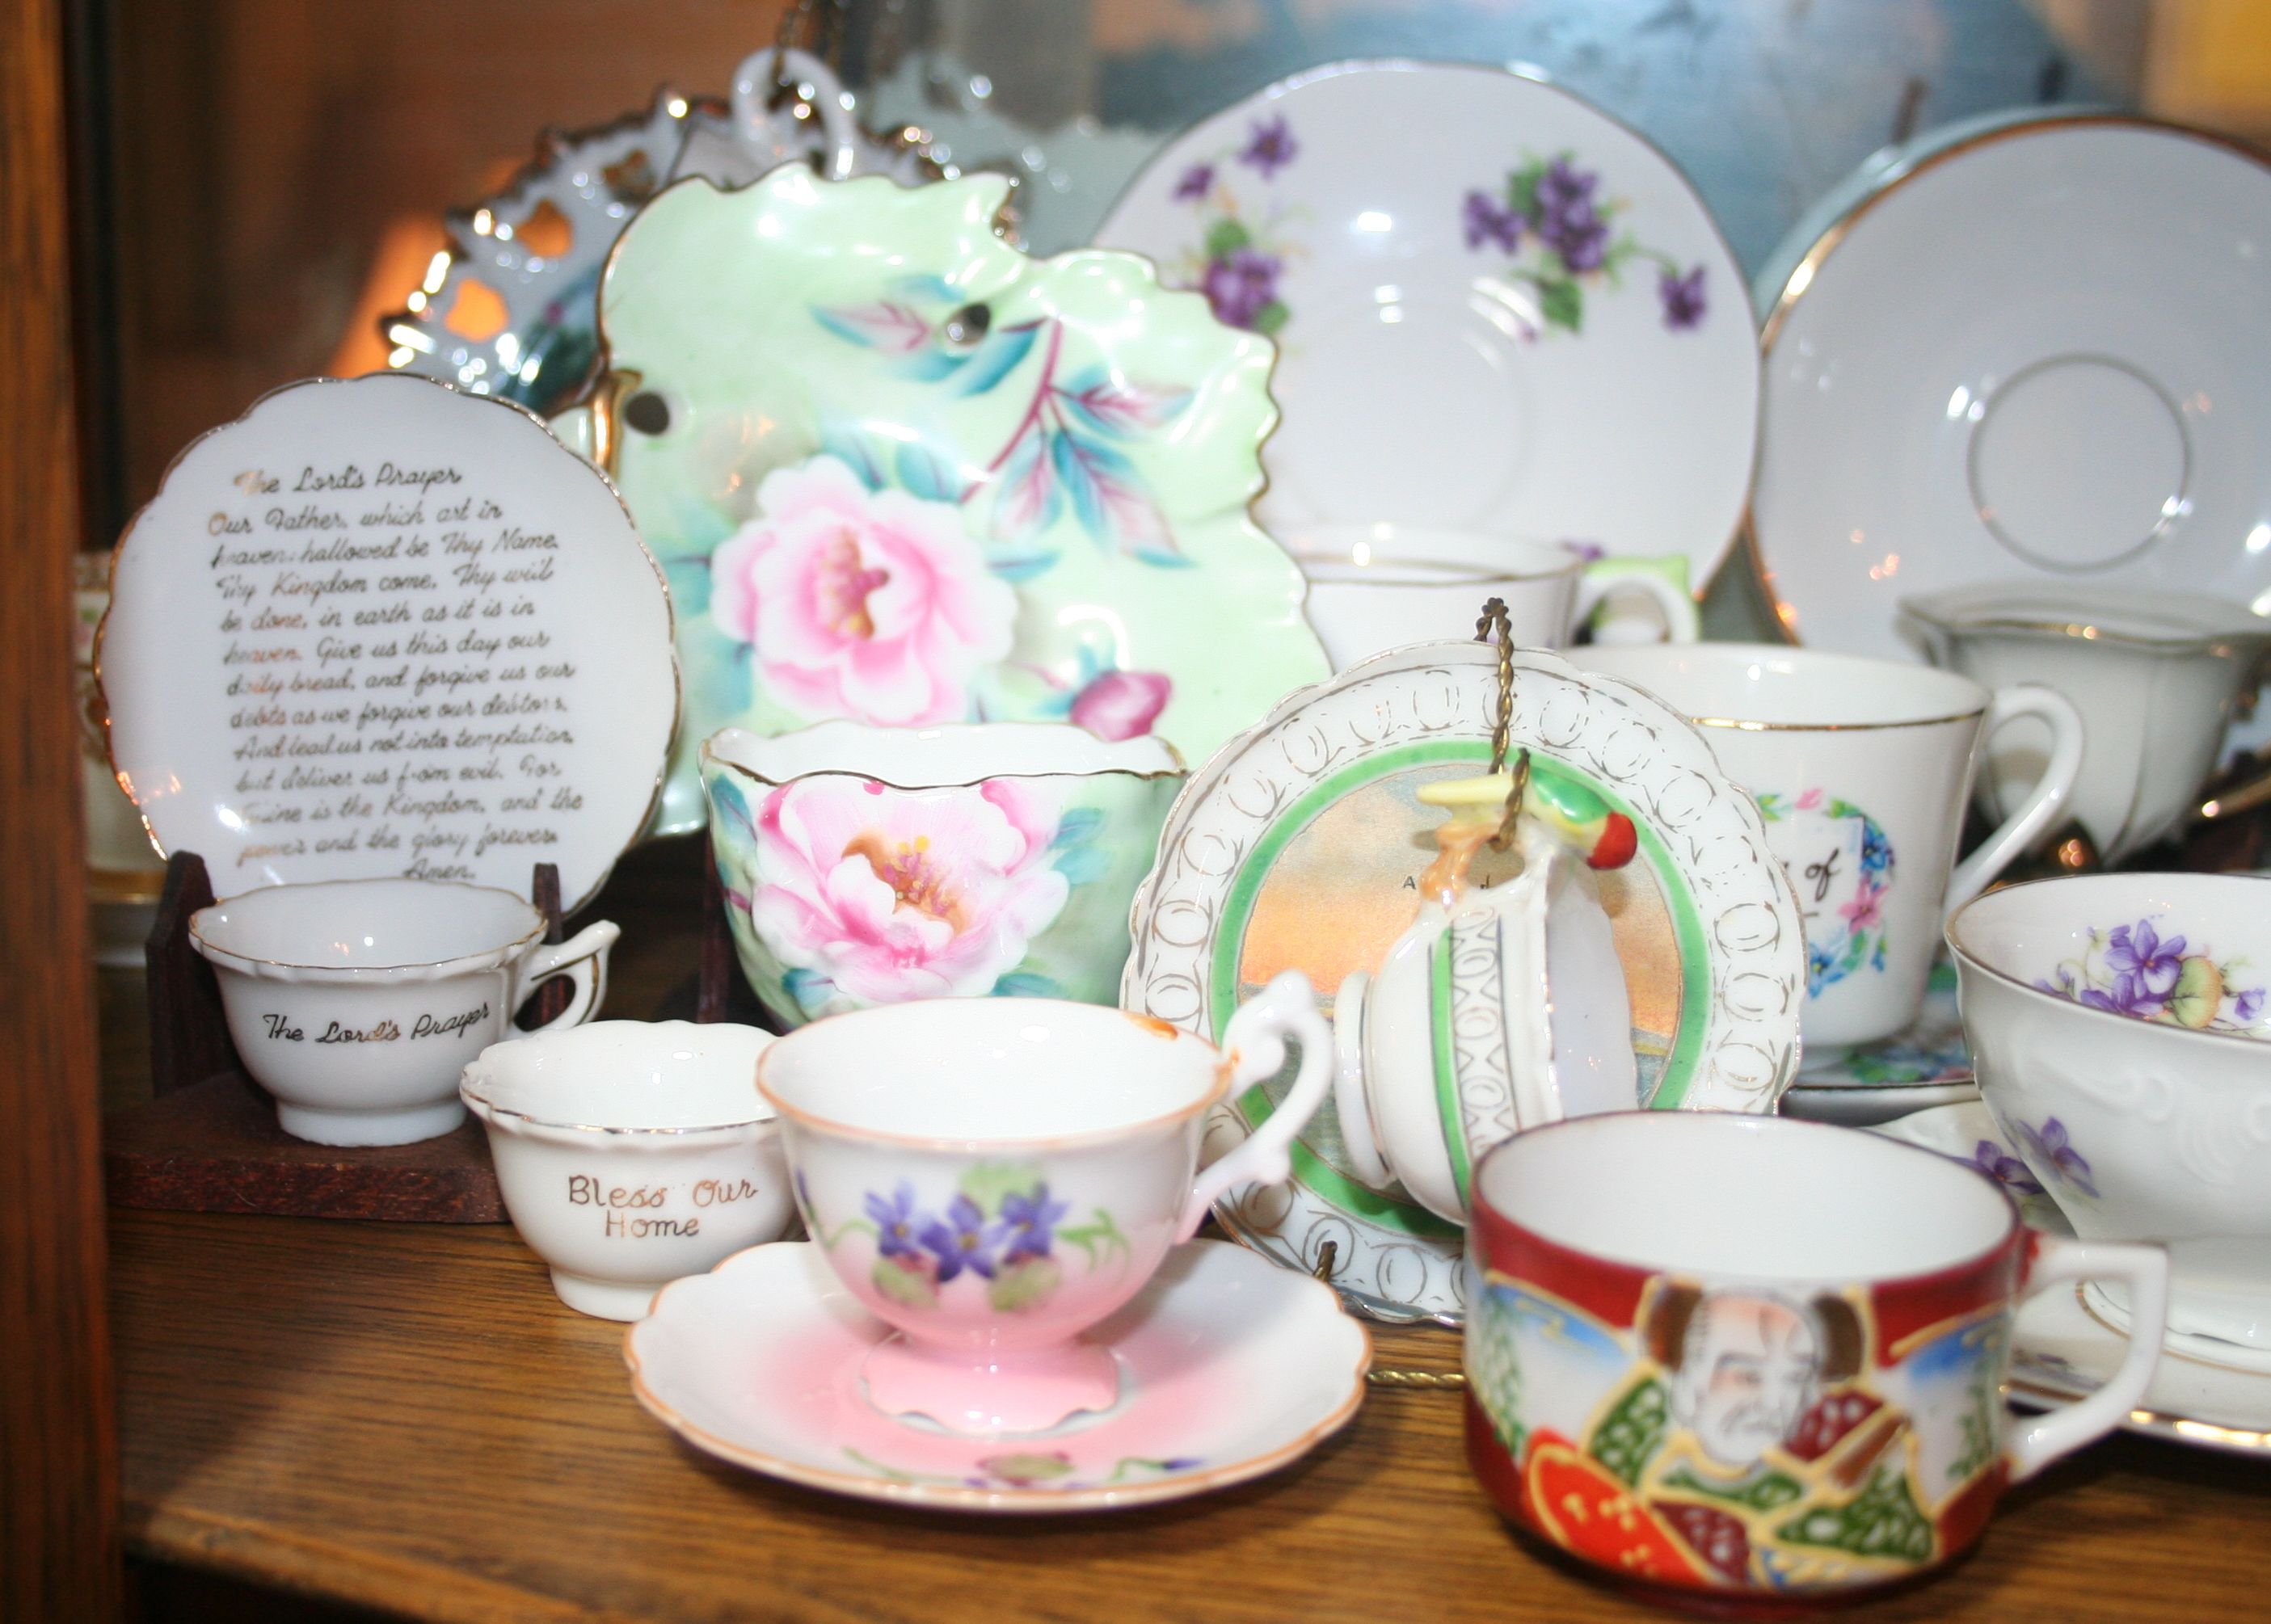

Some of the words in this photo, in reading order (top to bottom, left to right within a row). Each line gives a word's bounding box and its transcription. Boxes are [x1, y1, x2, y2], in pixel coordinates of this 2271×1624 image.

[234, 466, 280, 495] The
[292, 465, 364, 492] Lord's
[376, 462, 462, 494] Prayer
[209, 511, 252, 536] Our
[360, 499, 424, 526] which
[436, 497, 470, 522] art
[478, 499, 503, 520] in
[300, 536, 402, 563] hallowed
[405, 533, 429, 557] be
[441, 532, 483, 560] Thy
[271, 569, 367, 606] Kingdom
[453, 563, 495, 595] Thy
[503, 557, 554, 583] will
[221, 609, 241, 632] be
[319, 606, 341, 626] in
[354, 601, 411, 625] earth
[422, 606, 447, 622] as
[455, 598, 475, 620] it
[482, 599, 503, 617] is
[511, 595, 534, 616] in
[317, 637, 361, 667] Give
[371, 641, 397, 658] us
[406, 630, 448, 655] this
[457, 628, 501, 659] day
[508, 631, 550, 649] our
[366, 665, 409, 687] and
[414, 664, 489, 696] forgive
[499, 666, 526, 680] us
[536, 663, 575, 679] our
[230, 706, 286, 729] debts
[292, 709, 316, 725] as
[322, 709, 349, 723] we
[356, 700, 430, 730] forgive
[437, 700, 475, 717] our
[234, 734, 286, 760] And
[288, 733, 335, 756] lead
[337, 738, 361, 754] us
[369, 730, 404, 752] not
[406, 729, 448, 750] into
[281, 765, 352, 790] deliver
[363, 768, 389, 784] us
[242, 801, 301, 823] Tine
[310, 798, 331, 820] is
[339, 793, 373, 818] the
[501, 787, 543, 811] and
[548, 786, 583, 810] the
[315, 828, 357, 852] and
[367, 823, 399, 848] the
[412, 824, 469, 858] glory
[1805, 848, 1841, 902] of
[263, 1014, 304, 1041] The
[314, 1020, 401, 1044] Lord's
[411, 1002, 488, 1039] Prayer
[569, 1175, 668, 1208] Bless
[693, 1179, 759, 1207] Our
[605, 1210, 700, 1238] Home
